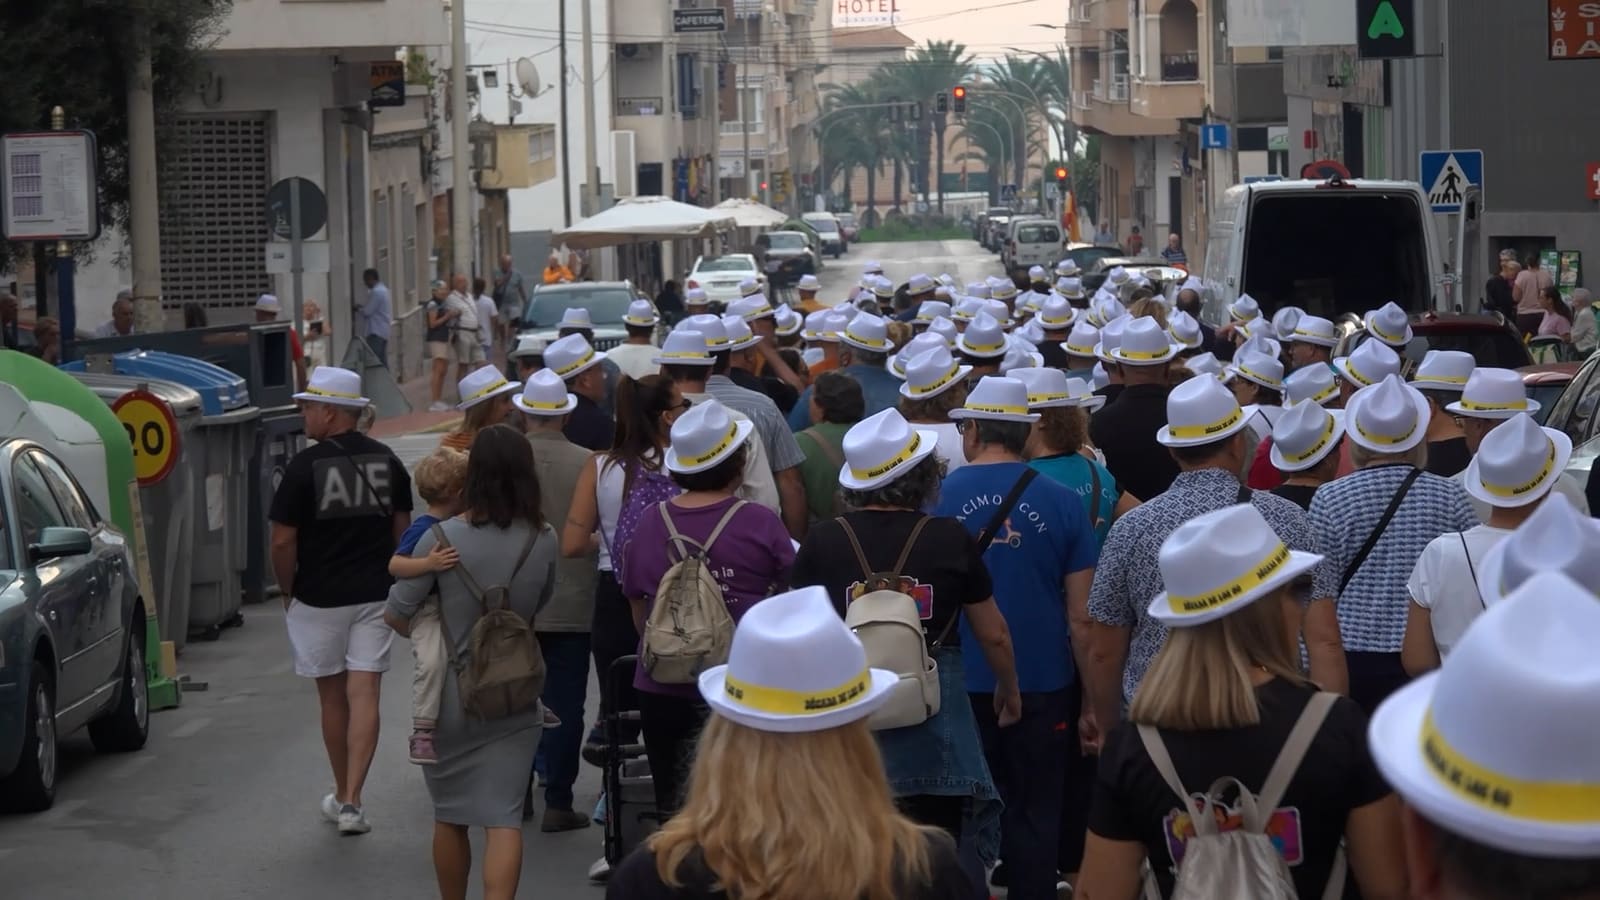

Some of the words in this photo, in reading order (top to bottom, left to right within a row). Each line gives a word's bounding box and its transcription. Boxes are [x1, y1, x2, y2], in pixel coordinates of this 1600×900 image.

[838, 0, 900, 13] HOTEL
[675, 15, 724, 26] CAFETERIA
[371, 65, 403, 78] ATM
[1208, 127, 1221, 145] L
[1019, 503, 1048, 534] CON
